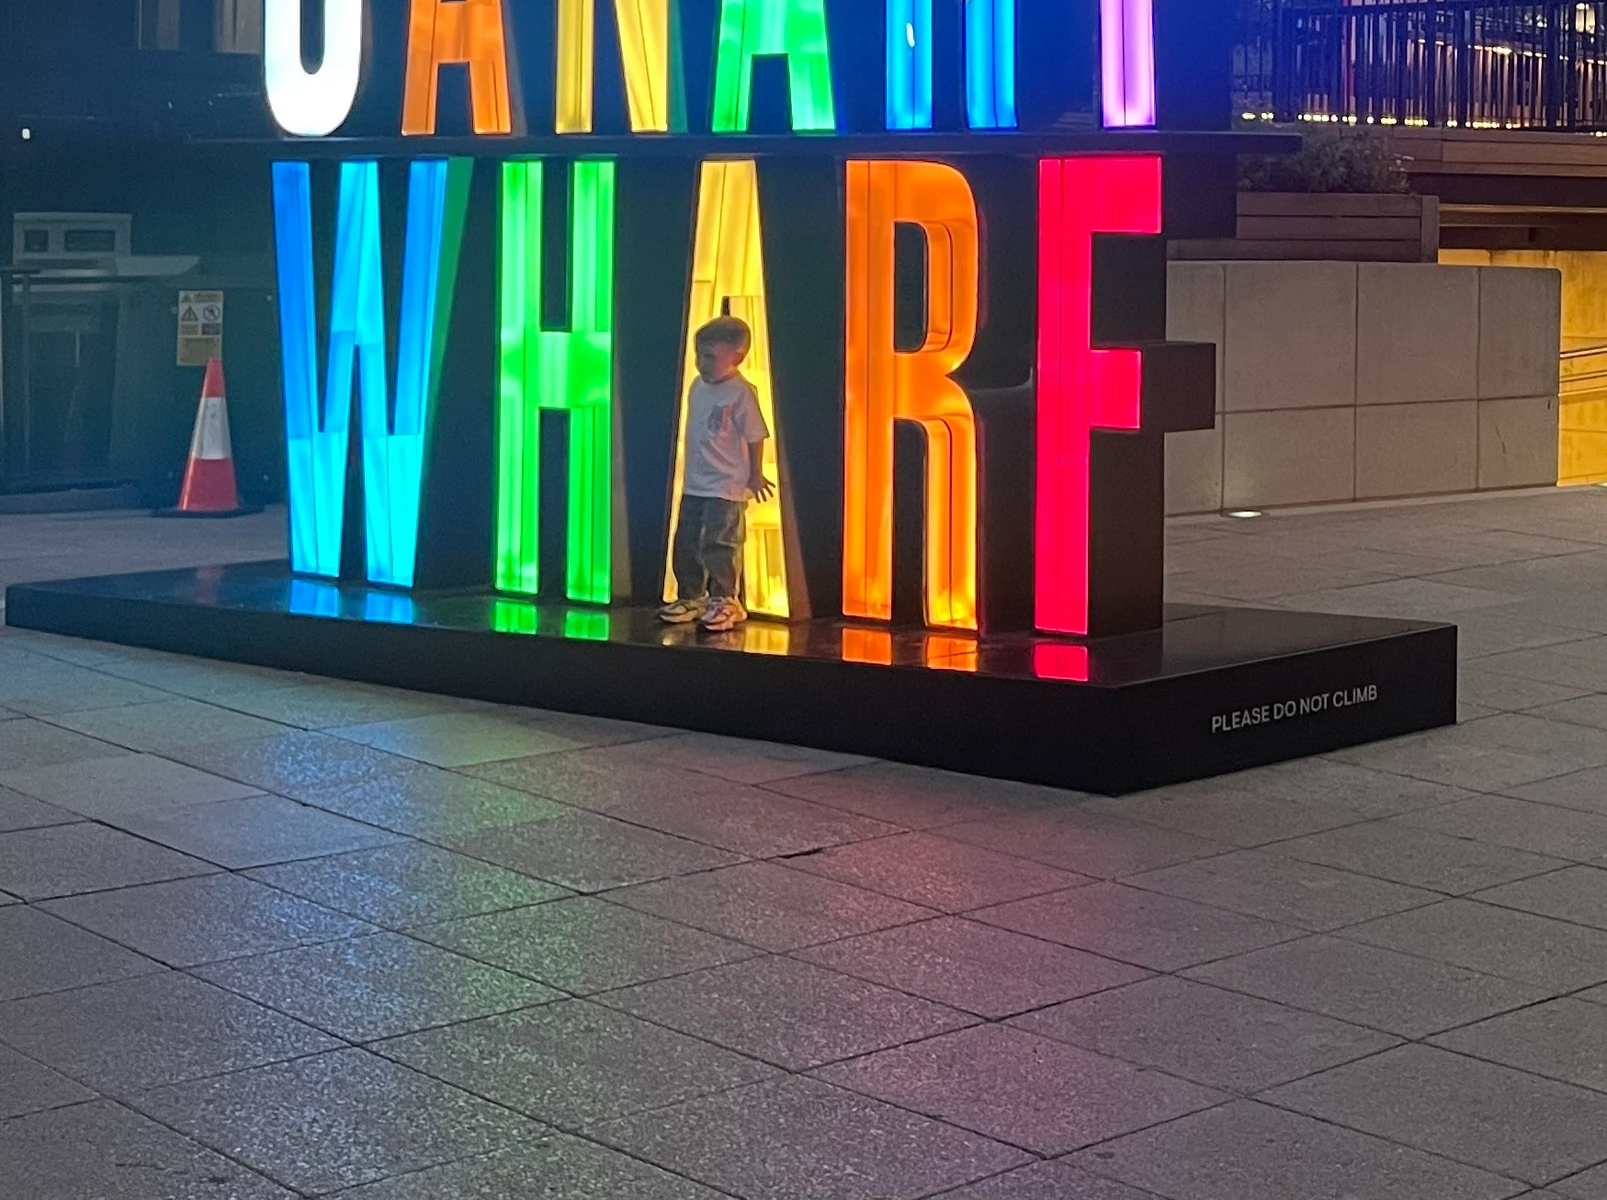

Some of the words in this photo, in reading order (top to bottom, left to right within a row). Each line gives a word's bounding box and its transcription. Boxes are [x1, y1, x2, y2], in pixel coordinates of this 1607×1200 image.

[271, 155, 1163, 636] WHARF
[1211, 705, 1271, 733] PLEASE
[1273, 700, 1296, 720] DO
[1299, 693, 1330, 715] NOT
[1332, 684, 1378, 708] CLIMB
